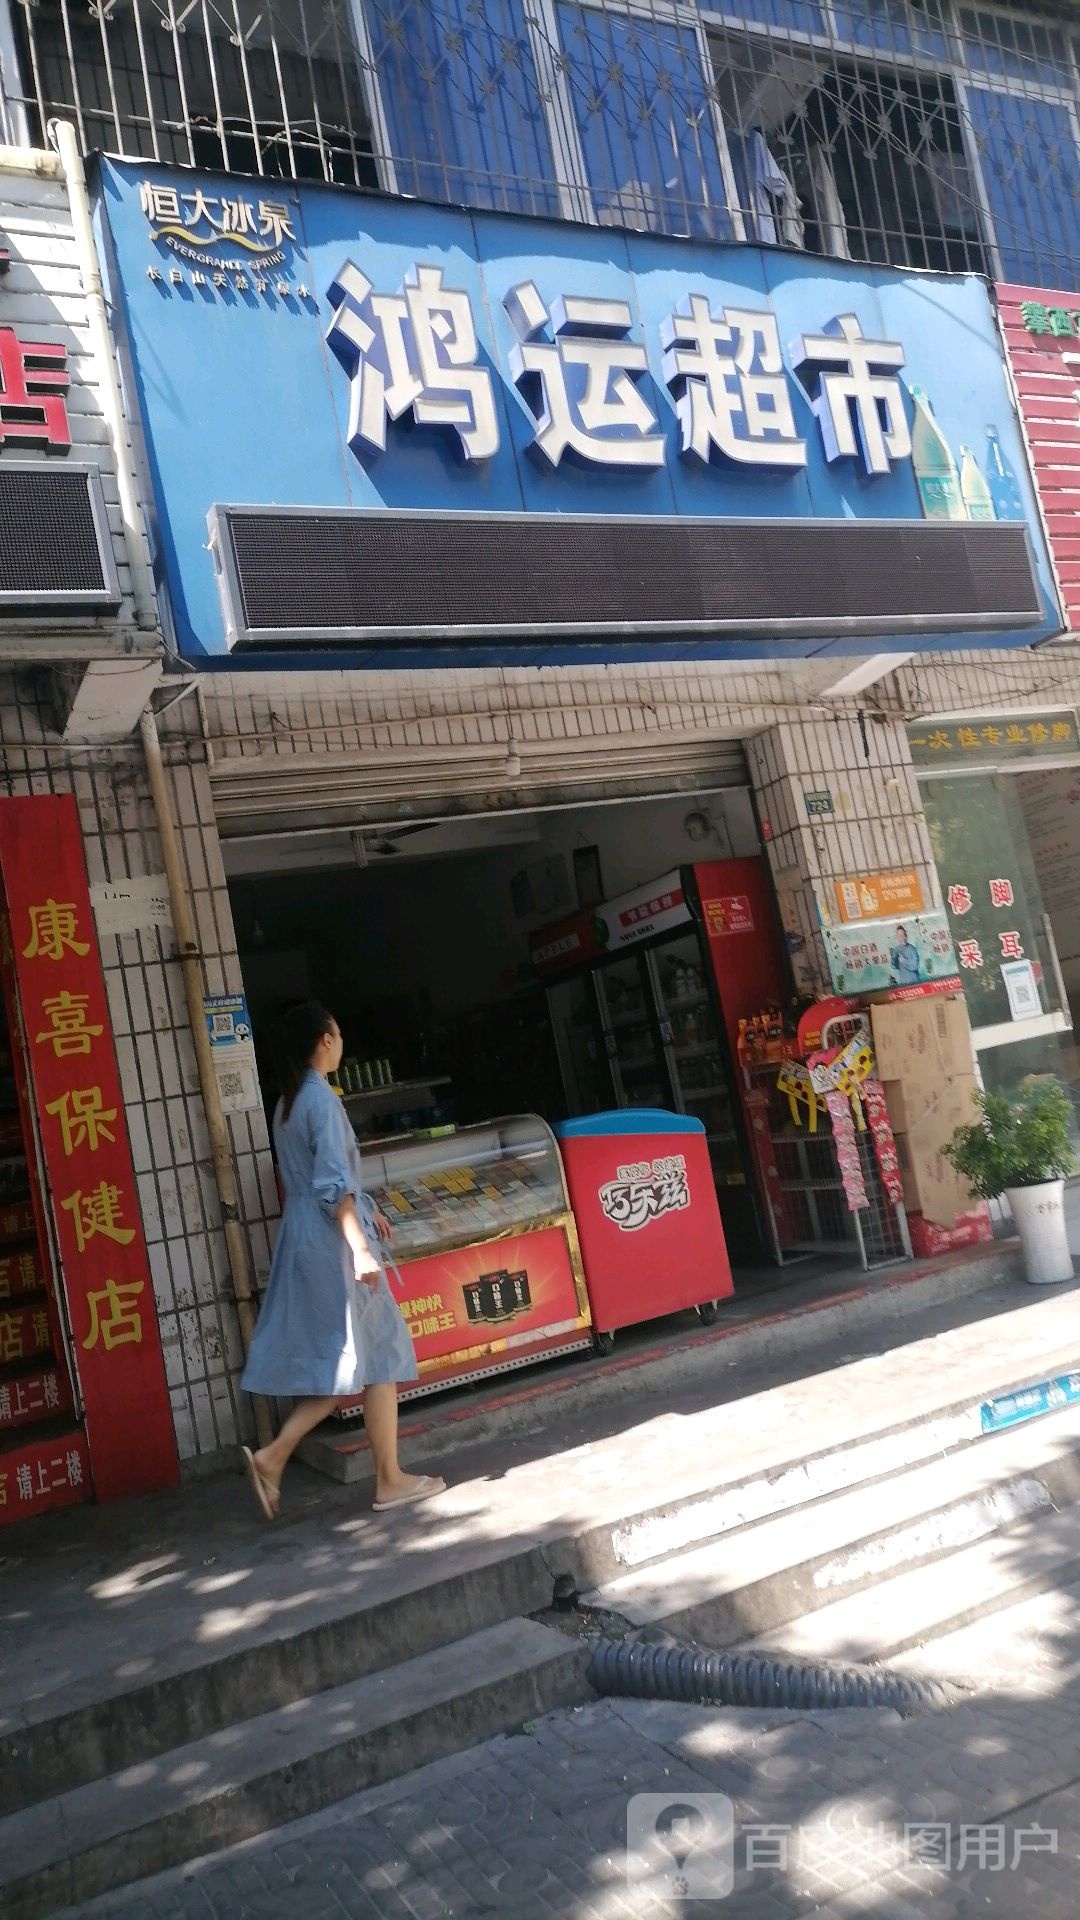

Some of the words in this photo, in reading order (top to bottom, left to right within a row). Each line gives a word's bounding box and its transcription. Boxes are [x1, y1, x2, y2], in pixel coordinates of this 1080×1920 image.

[140, 180, 297, 248] 恒大冰泉
[249, 251, 287, 270] SPRING
[326, 258, 913, 475] 鸿运超市
[909, 721, 1072, 749] 一次性专业修脚
[809, 800, 829, 812] 724
[947, 878, 1014, 915] 修脚
[958, 931, 1025, 969] 采耳
[22, 898, 146, 1351] 康喜保健店
[408, 1311, 457, 1339] 口味王
[16, 1450, 83, 1501] 请上二楼
